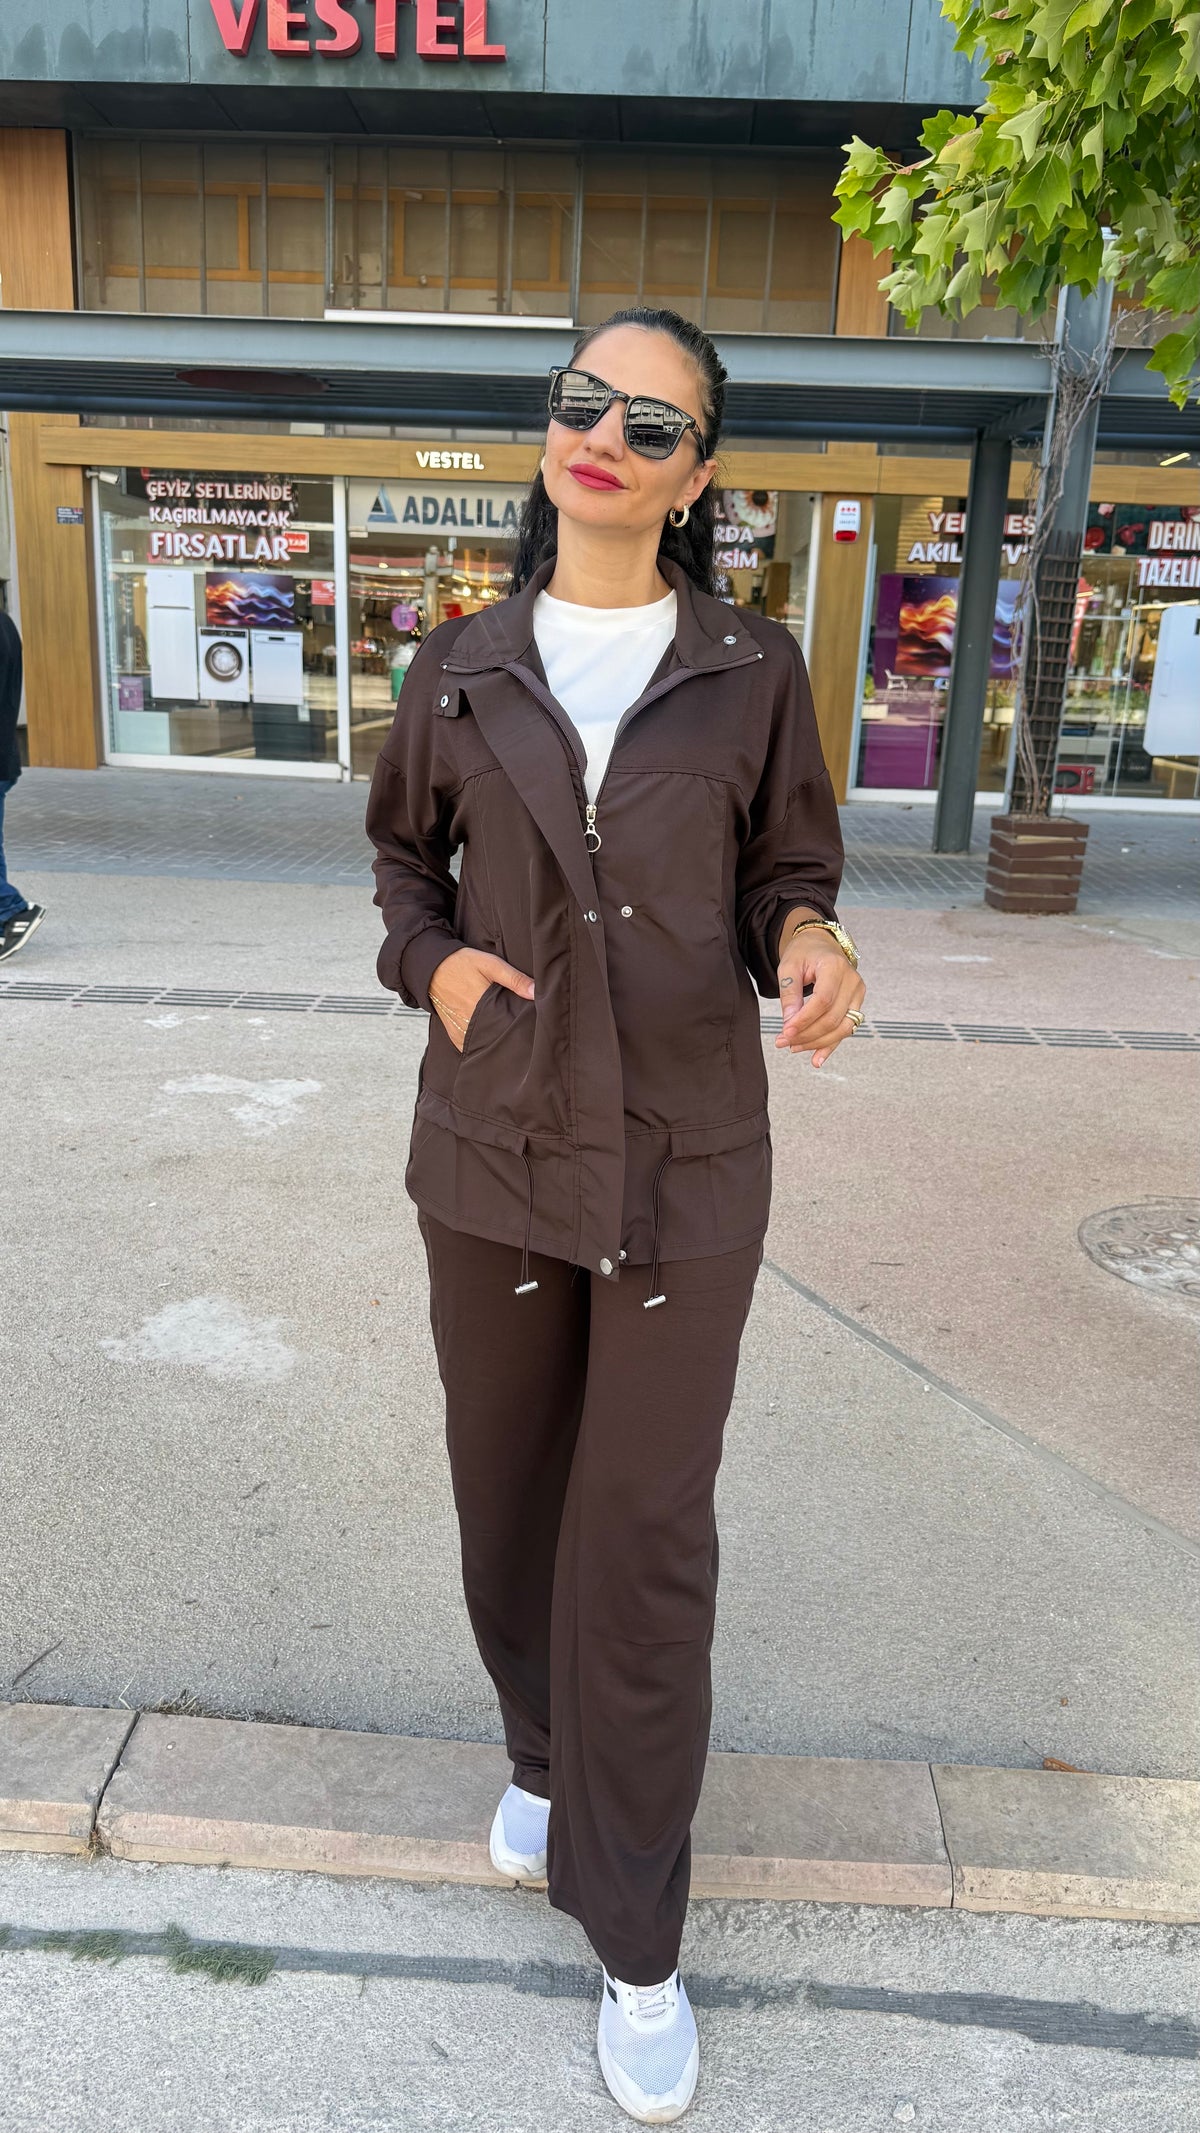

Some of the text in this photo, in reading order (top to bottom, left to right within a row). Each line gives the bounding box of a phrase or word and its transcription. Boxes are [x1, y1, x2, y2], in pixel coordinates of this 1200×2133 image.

[209, 0, 507, 61] VESTEL
[415, 450, 485, 470] VESTEL
[146, 478, 292, 501] ÇEYİZ SETLERİNDE
[150, 506, 291, 528] KAÇIRILMAYACAK
[151, 531, 291, 561] FIRSATLAR
